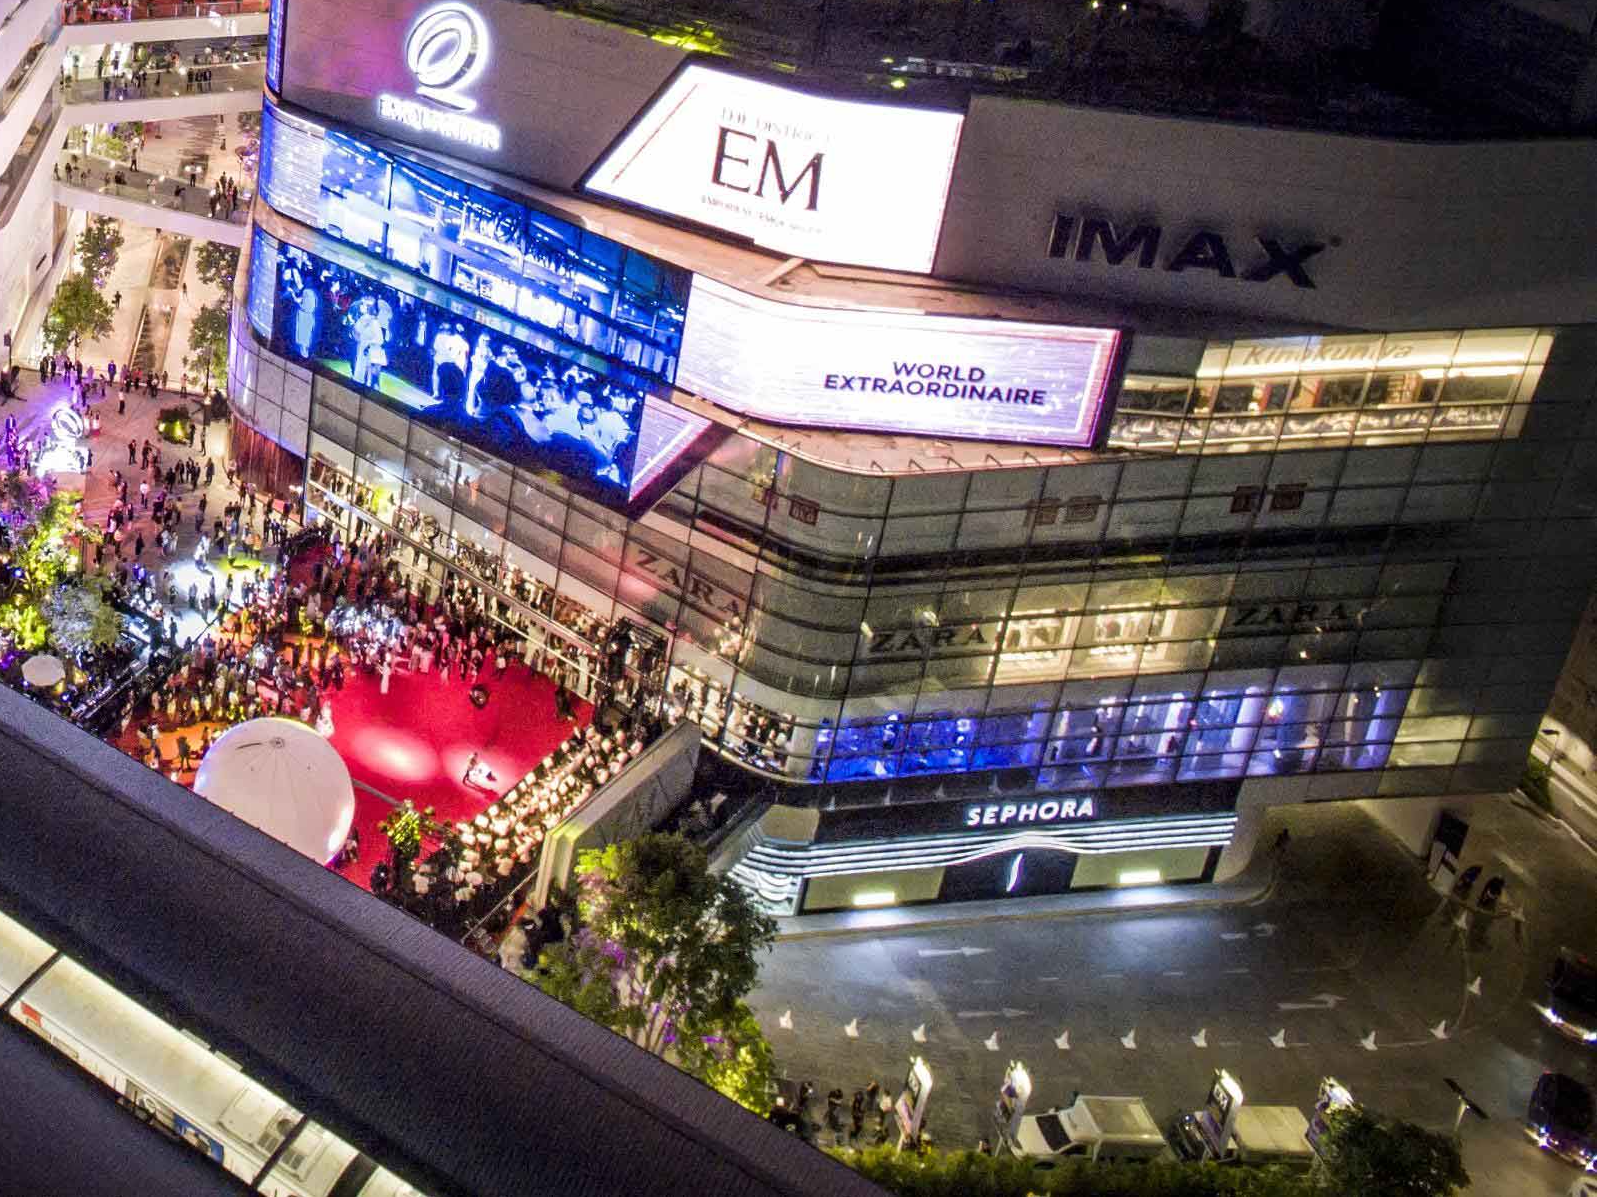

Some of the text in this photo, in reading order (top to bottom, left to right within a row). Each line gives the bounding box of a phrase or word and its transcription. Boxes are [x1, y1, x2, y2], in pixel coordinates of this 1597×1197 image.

[711, 125, 825, 212] EM
[1046, 213, 1326, 289] IMAX
[893, 361, 985, 383] WORLD
[824, 374, 1047, 405] EXTRAORDINAIRE
[636, 550, 744, 618] ZARA
[869, 626, 988, 652] ZARA
[967, 797, 1094, 826] SEPHORA
